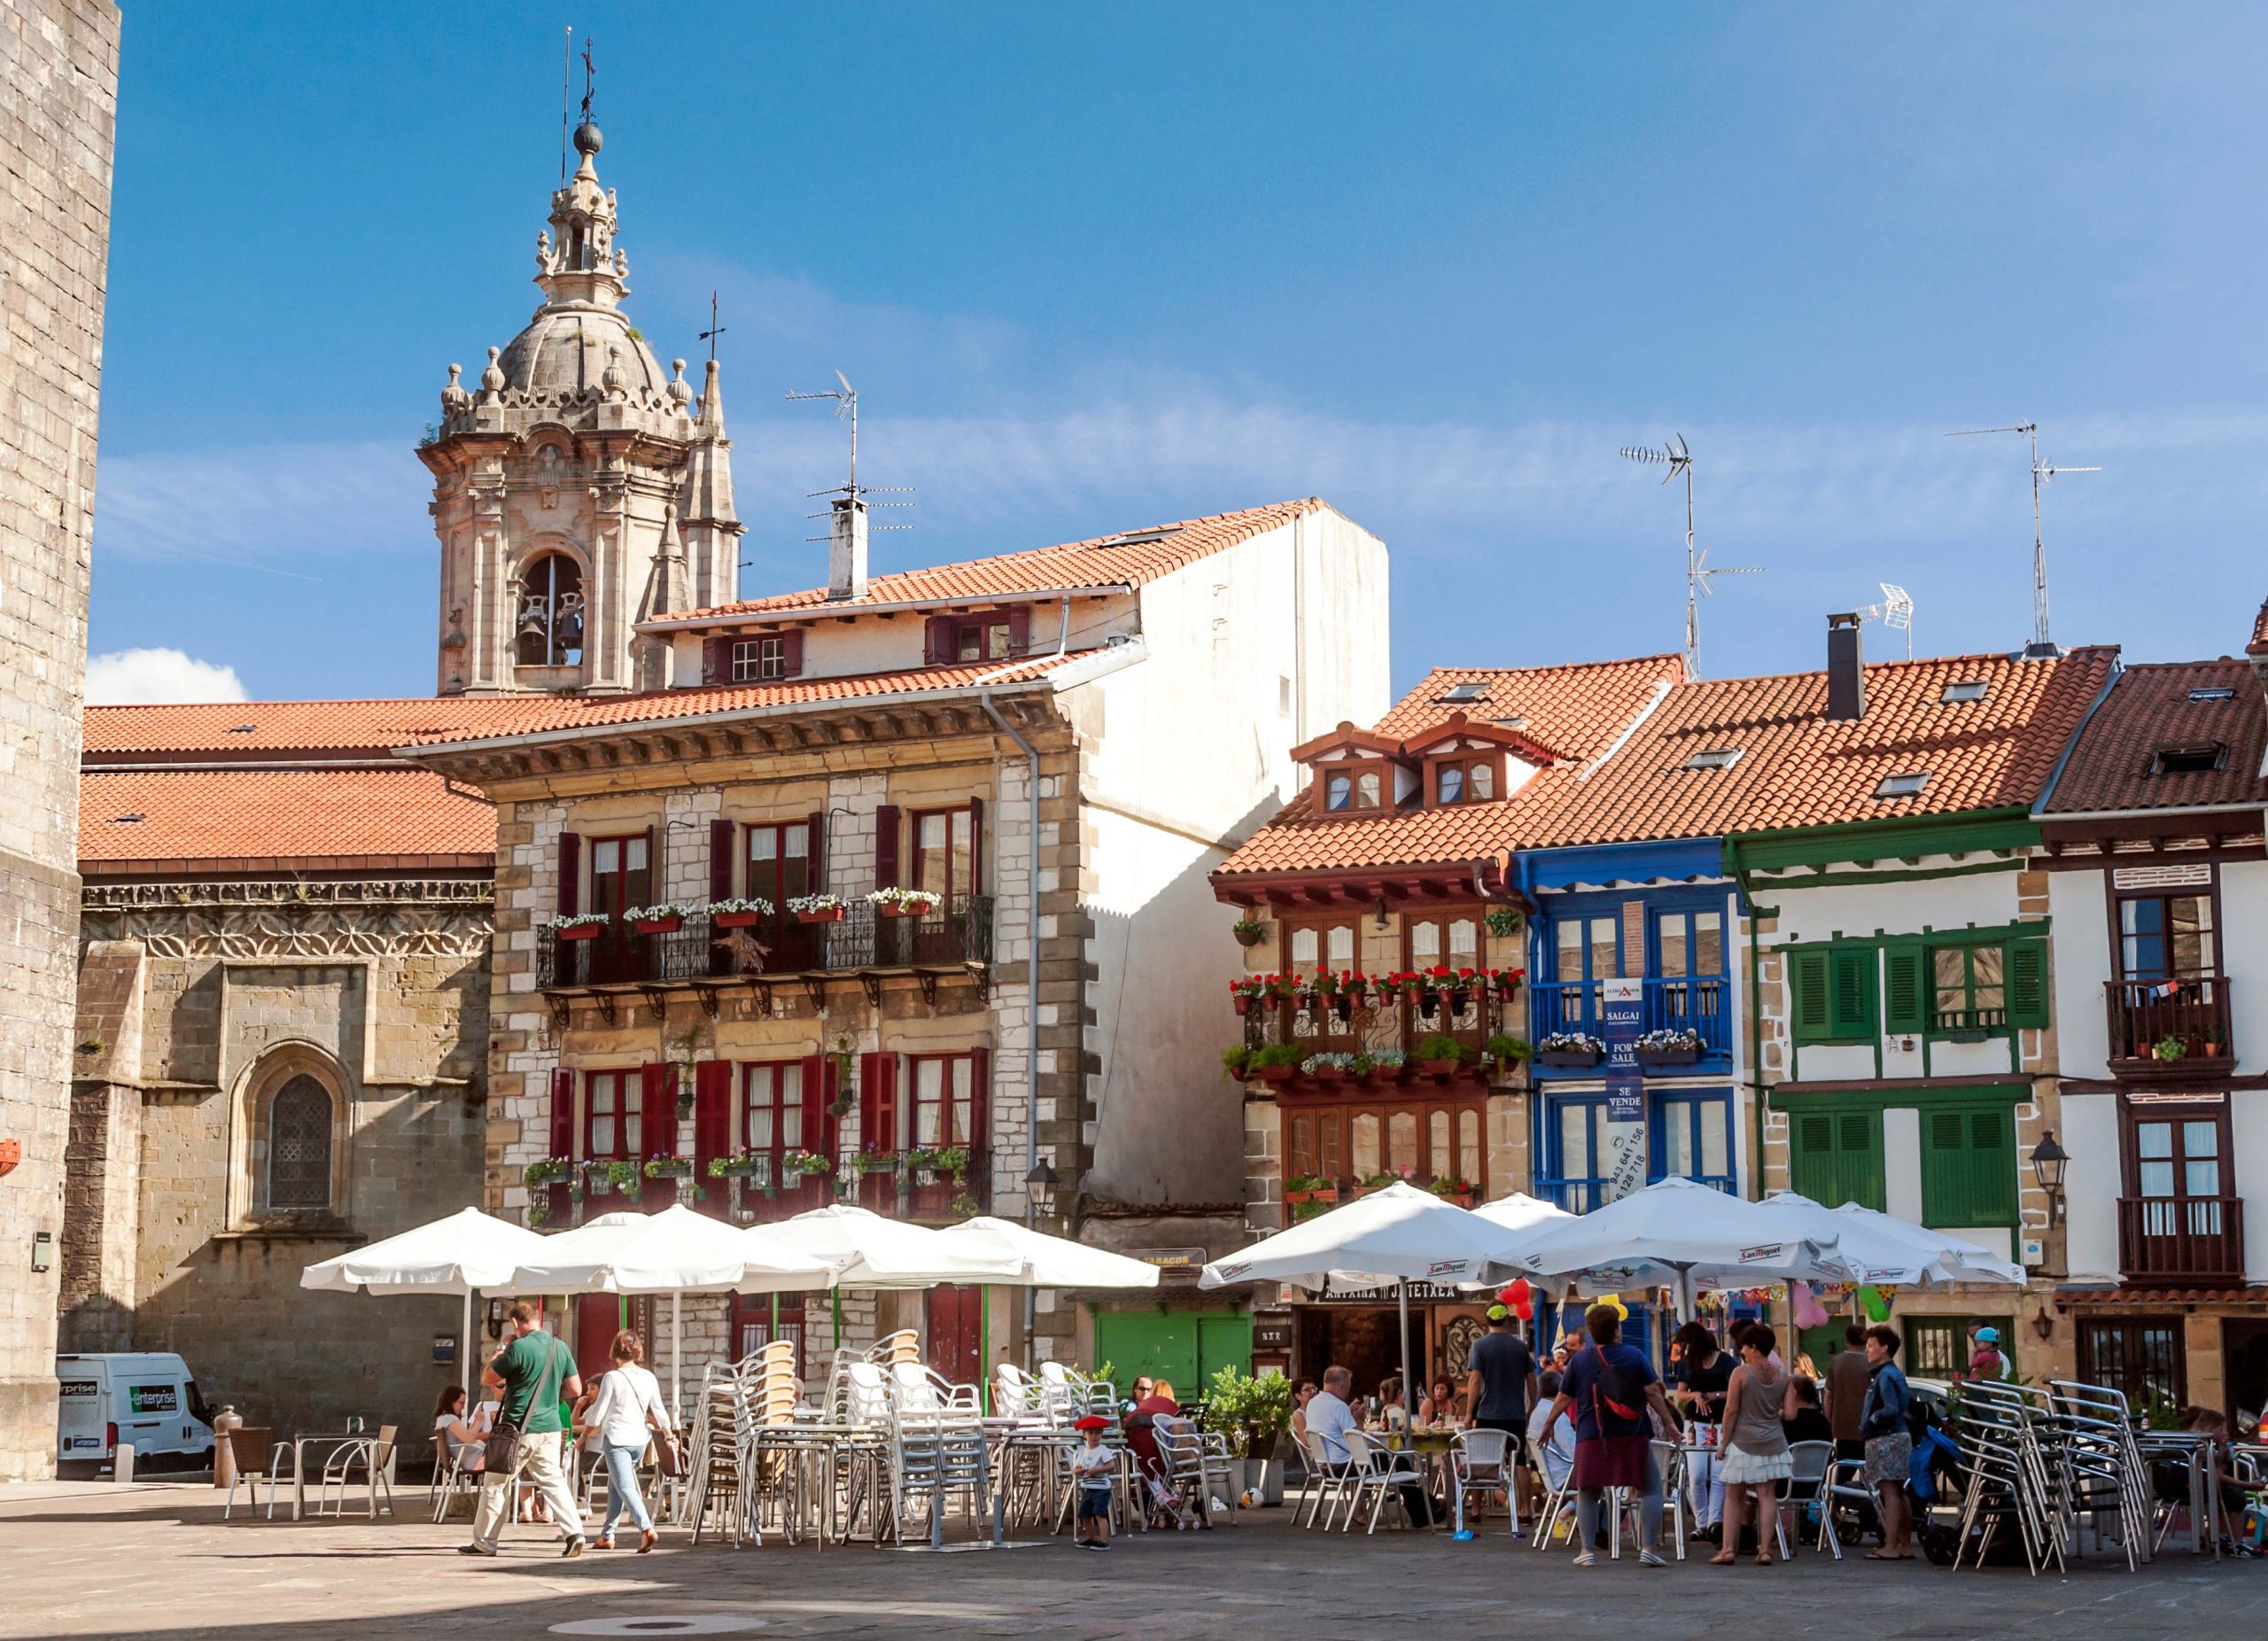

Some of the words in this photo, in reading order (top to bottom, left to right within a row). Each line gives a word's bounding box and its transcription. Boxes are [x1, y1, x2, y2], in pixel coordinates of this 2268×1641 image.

[1607, 1012, 1639, 1021] SALGAI
[1613, 1044, 1633, 1053] FOR
[1612, 1054, 1635, 1062] SALE
[1619, 1087, 1631, 1096] SE
[1609, 1097, 1642, 1107] VENDE
[1610, 1166, 1623, 1184] 943
[1619, 1147, 1633, 1165] 641
[1630, 1128, 1644, 1145] 156
[1620, 1174, 1635, 1192] 128
[1630, 1155, 1645, 1173] 718
[1391, 1284, 1455, 1298] JTETXEA
[132, 1389, 175, 1409] enterprise
